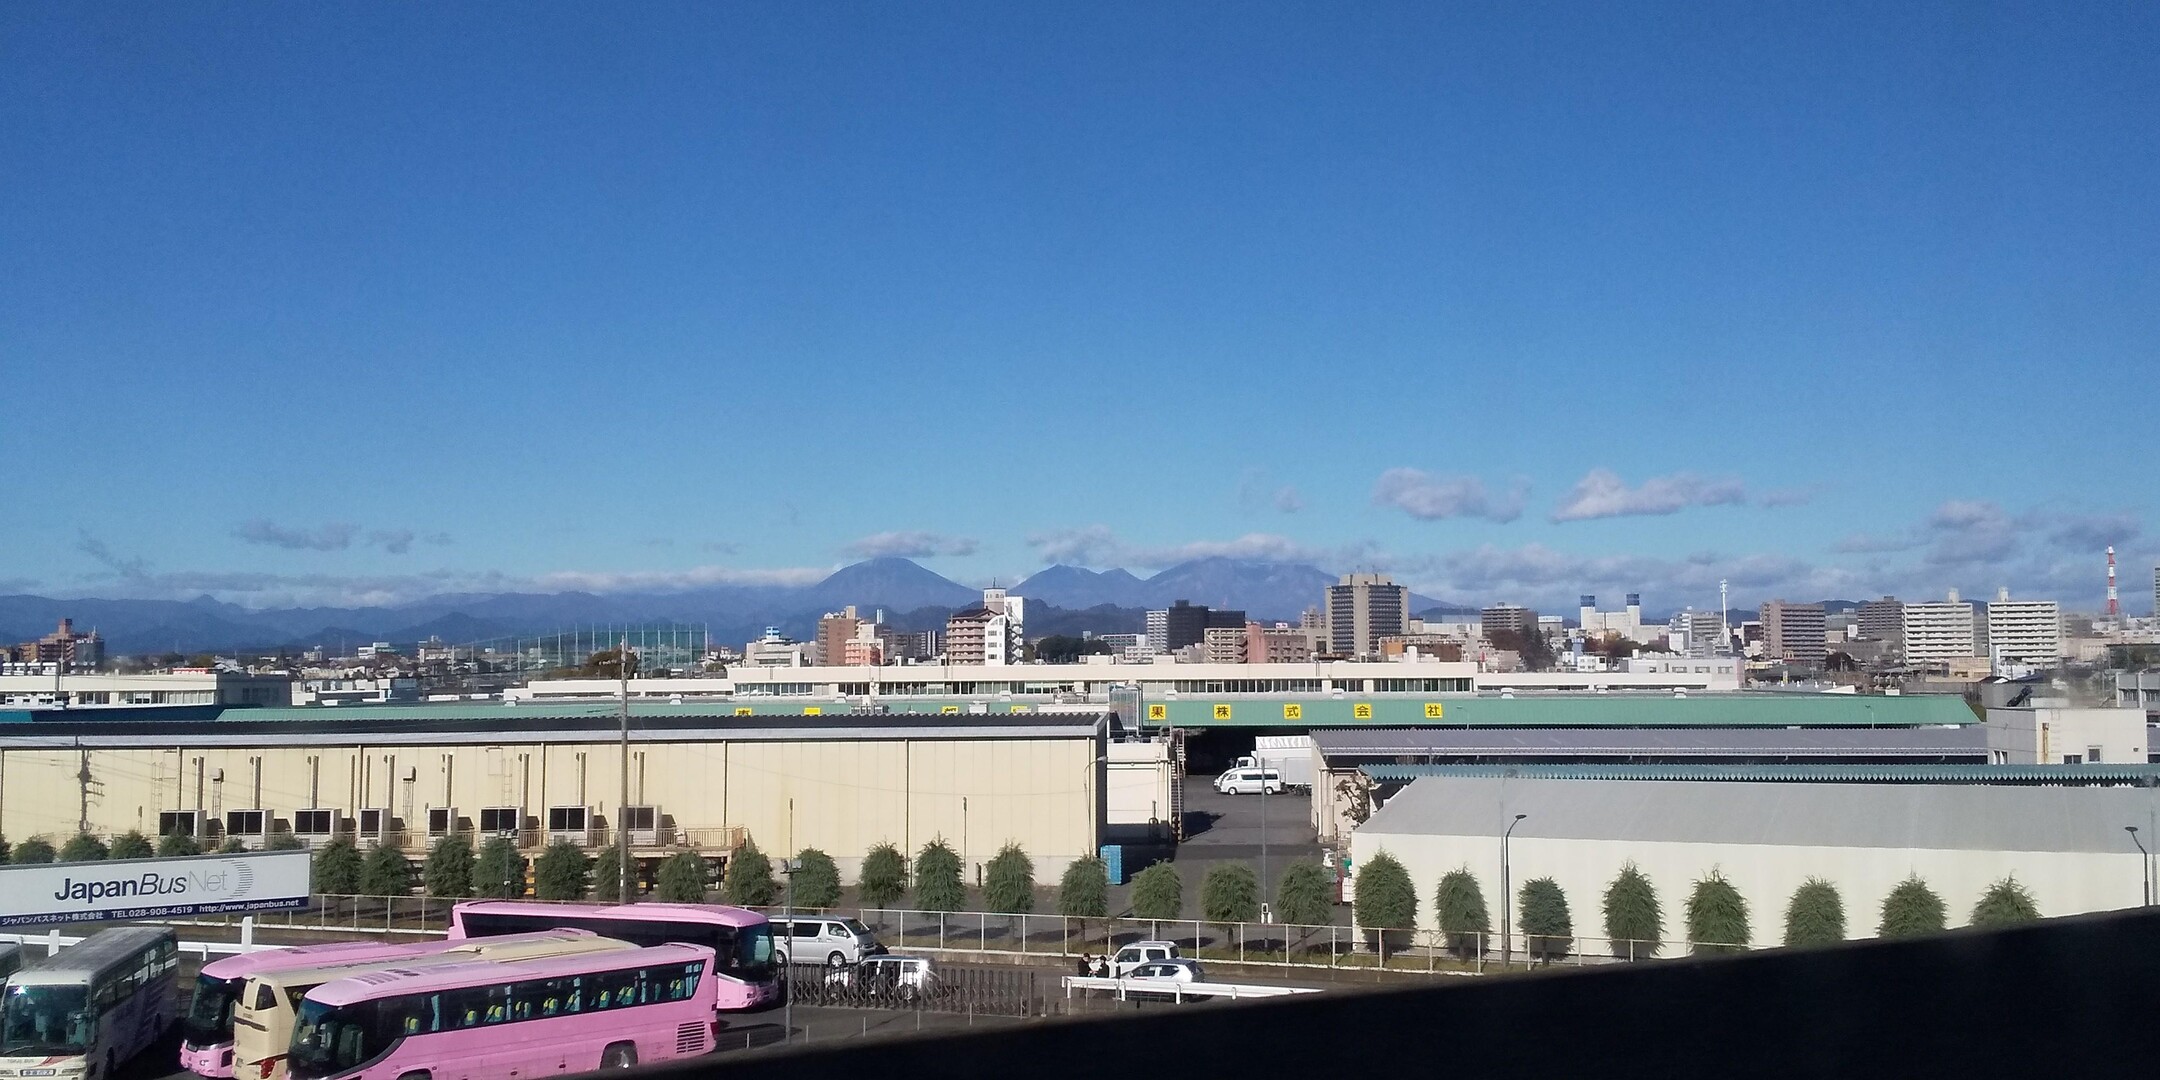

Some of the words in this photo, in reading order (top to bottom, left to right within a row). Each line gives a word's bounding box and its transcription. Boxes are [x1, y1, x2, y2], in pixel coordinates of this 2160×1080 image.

[2, 911, 104, 926] ジャパンバスネット株式会社
[199, 900, 299, 913] http://www.japanbus.net
